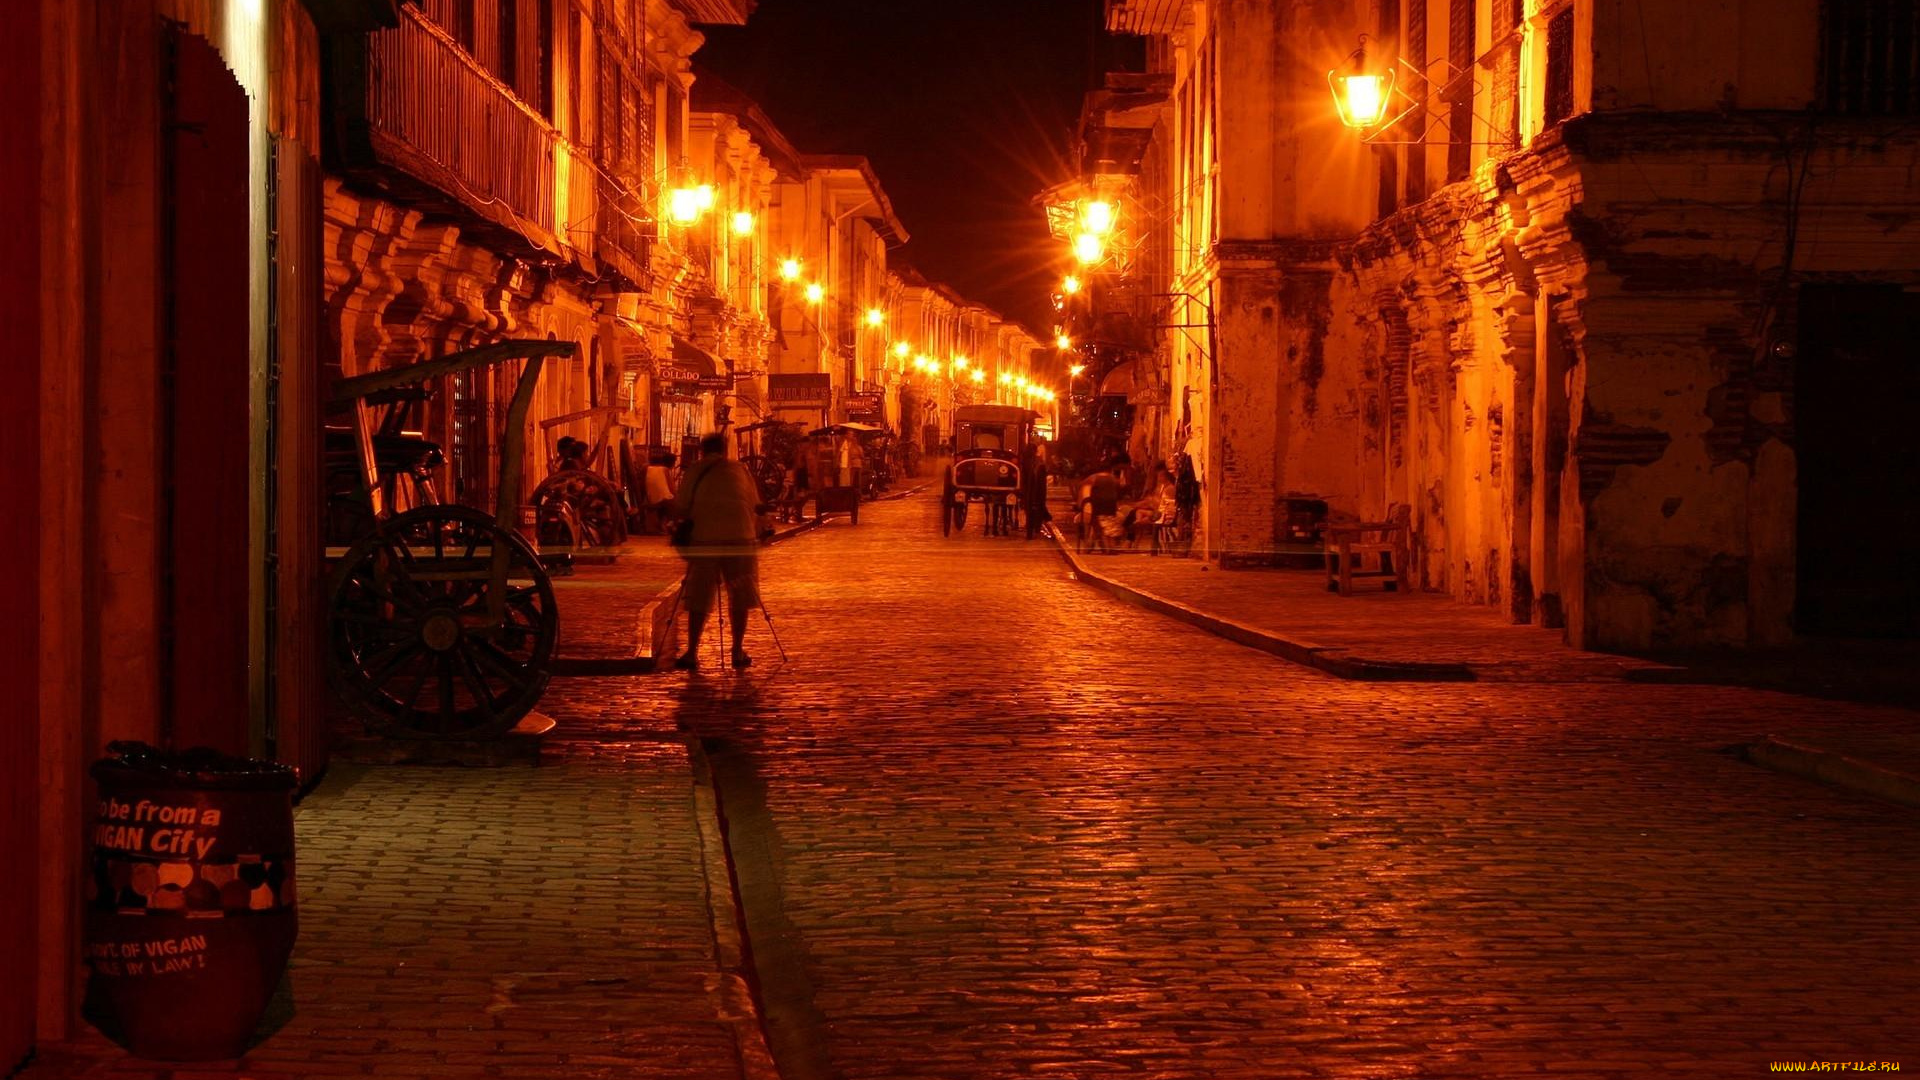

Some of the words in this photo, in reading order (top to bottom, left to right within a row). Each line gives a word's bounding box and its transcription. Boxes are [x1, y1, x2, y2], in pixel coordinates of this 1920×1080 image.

[109, 798, 130, 819] be
[135, 799, 197, 825] from
[200, 809, 222, 827] a
[150, 828, 217, 861] City
[121, 942, 141, 958] OF
[144, 935, 207, 957] VIGAN
[126, 961, 144, 977] BY
